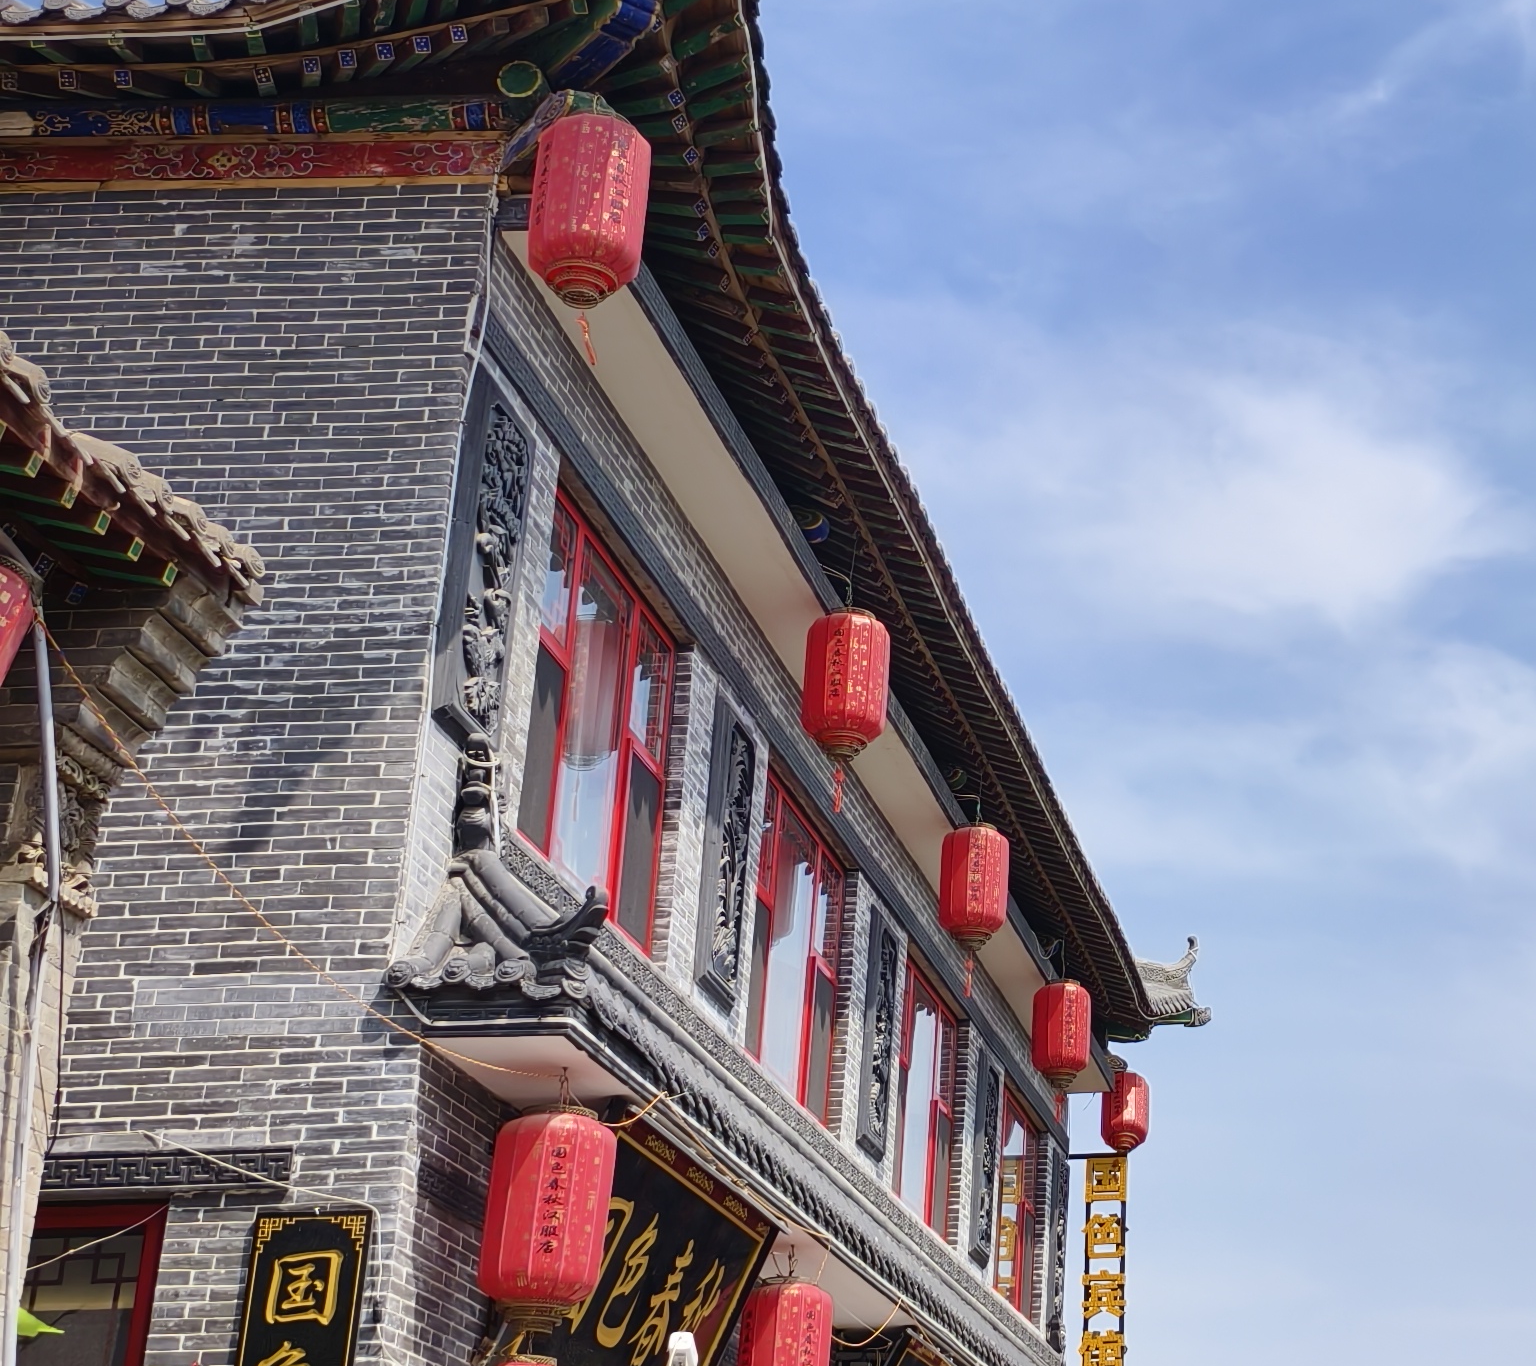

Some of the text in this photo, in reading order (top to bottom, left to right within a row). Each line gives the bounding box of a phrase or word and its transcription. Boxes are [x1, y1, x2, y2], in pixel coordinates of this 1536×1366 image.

[536, 1145, 568, 1254] 国色春秋汉服店
